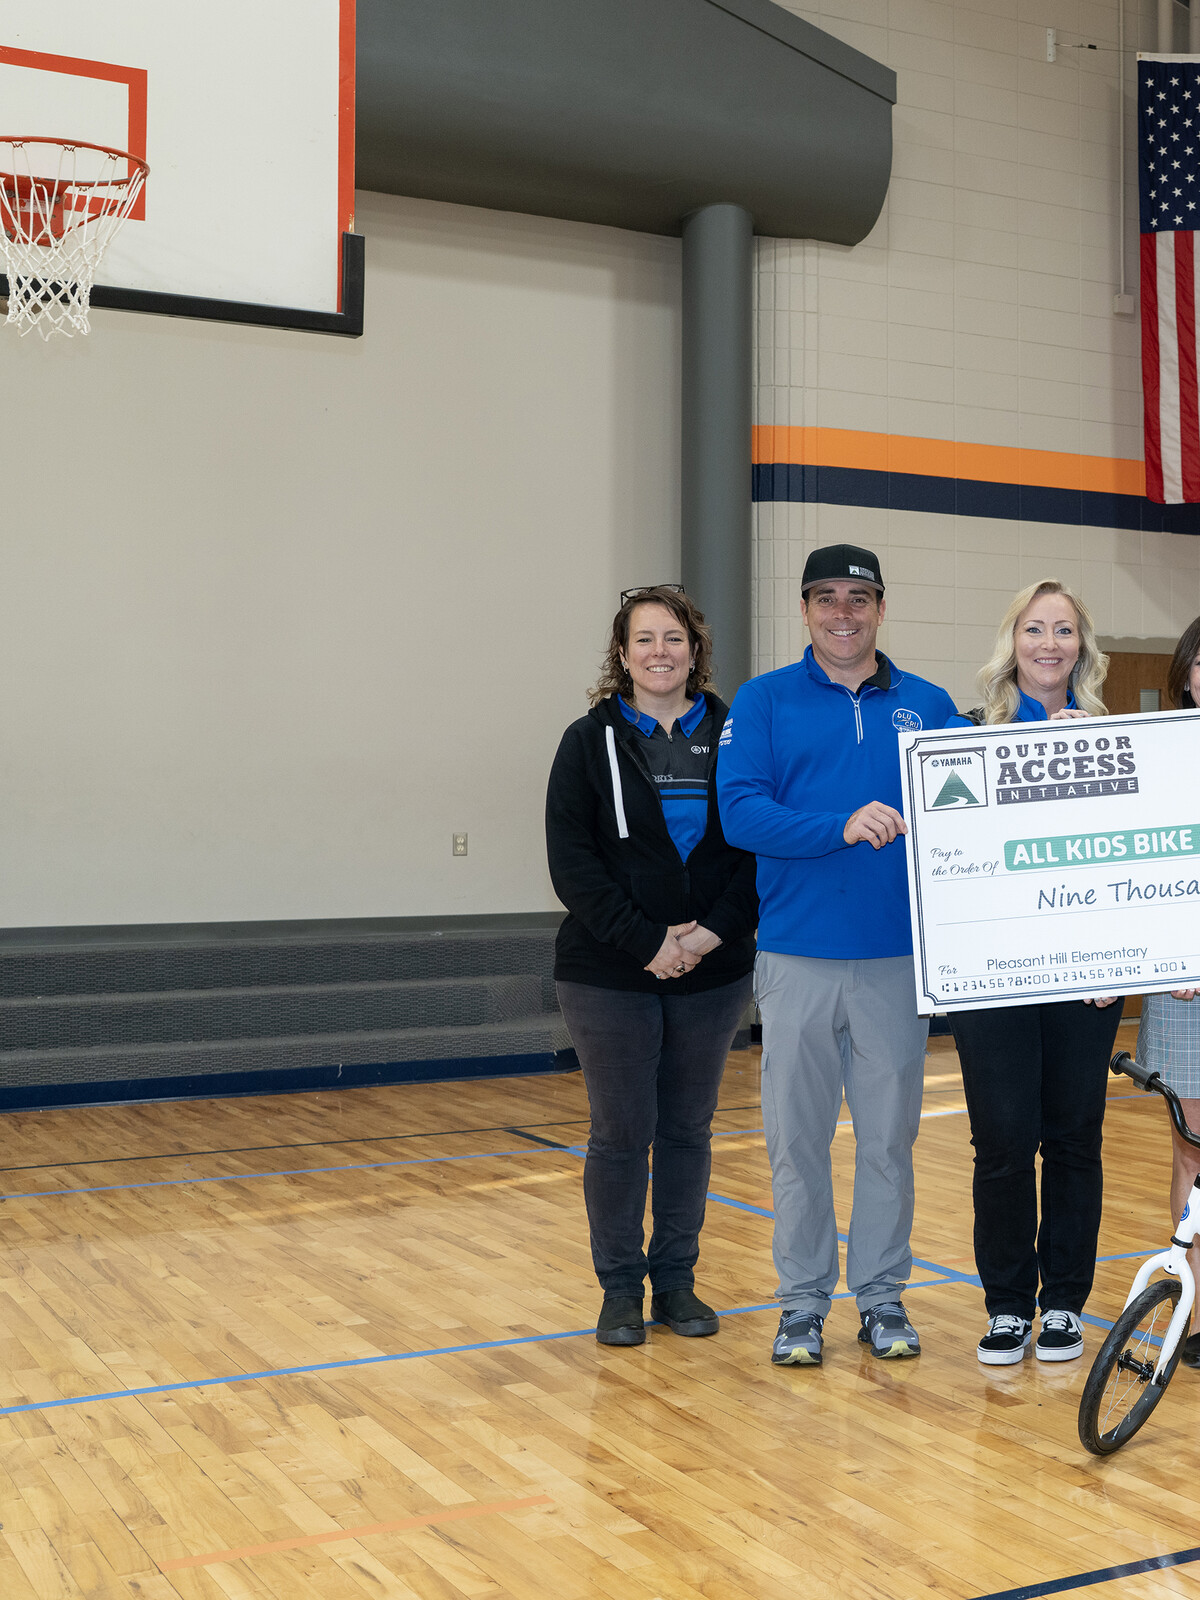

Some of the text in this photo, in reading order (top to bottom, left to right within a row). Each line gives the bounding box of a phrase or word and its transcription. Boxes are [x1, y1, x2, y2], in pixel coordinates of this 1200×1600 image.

[995, 736, 1132, 760] OUTDOOR
[940, 756, 973, 767] YAMAHA
[997, 751, 1136, 786] ACCESS
[998, 780, 1136, 802] INITIATIVE
[930, 847, 964, 863] Pay to
[1012, 841, 1060, 867] ALL
[1065, 834, 1128, 861] KIDS
[1133, 828, 1194, 855] BIKE
[931, 860, 1000, 877] the Order Of
[1037, 884, 1097, 911] Nine
[938, 946, 1148, 976] For Pleasant Hill Elementary
[1153, 961, 1187, 973] 1001
